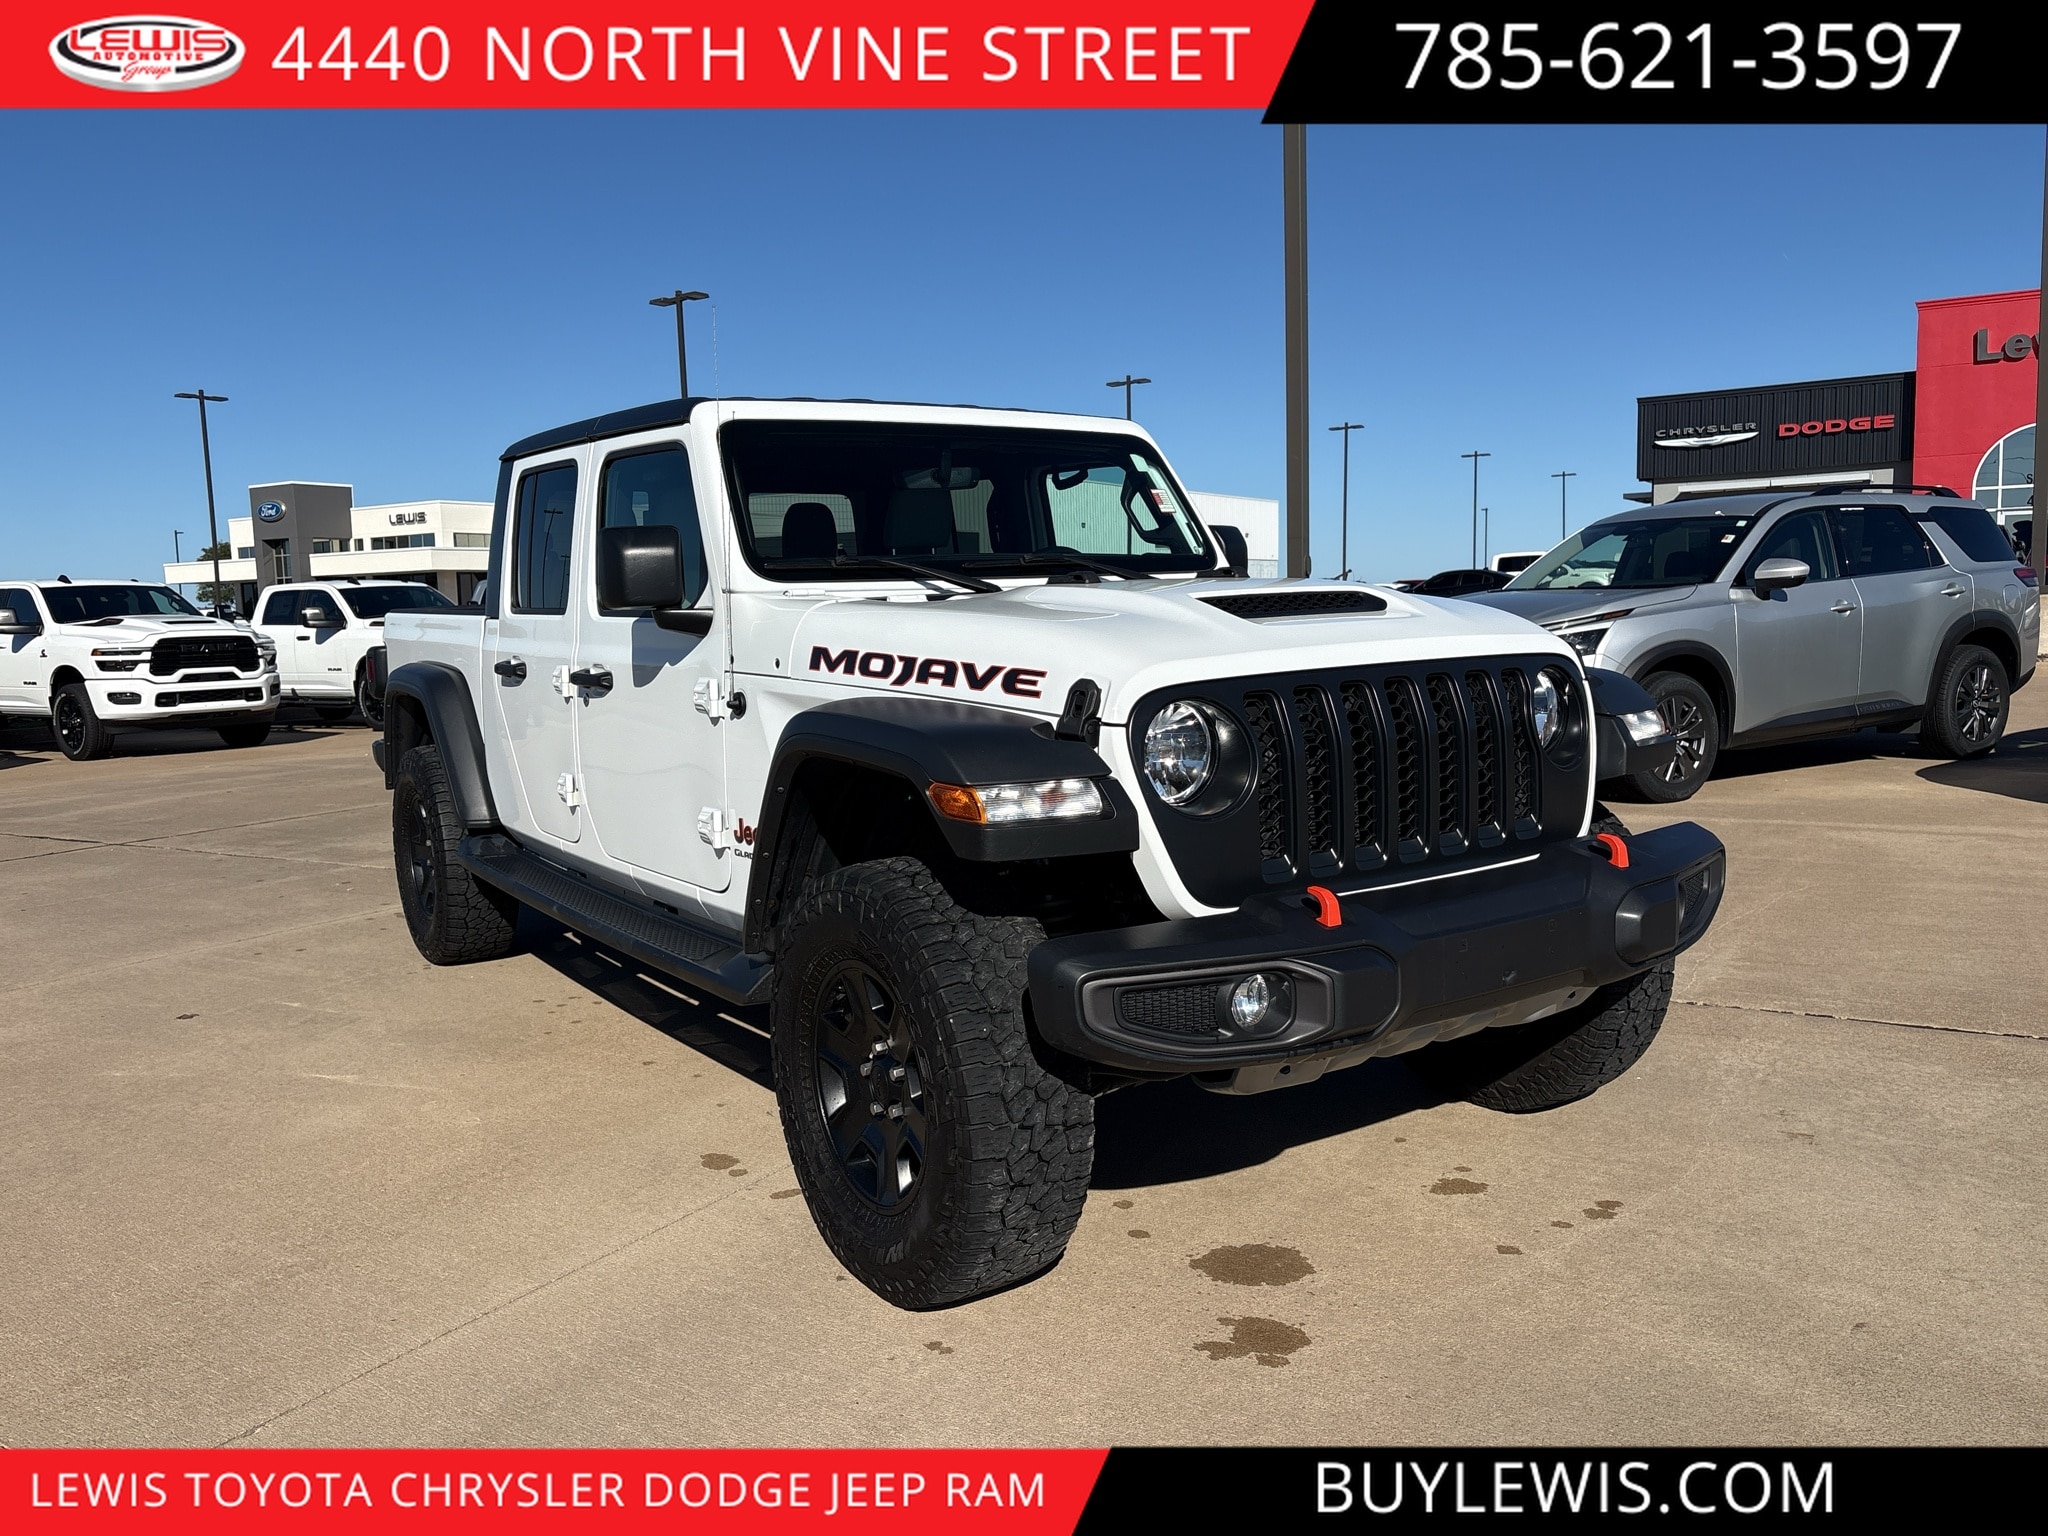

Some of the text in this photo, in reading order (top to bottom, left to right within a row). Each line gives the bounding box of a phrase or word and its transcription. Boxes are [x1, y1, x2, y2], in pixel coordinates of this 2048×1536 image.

[1655, 422, 1757, 437] CHRYSLER
[1778, 414, 1895, 437] DODGE
[260, 504, 277, 517] Ford
[389, 512, 427, 526] LEWIS
[809, 645, 1048, 699] MOJAVE
